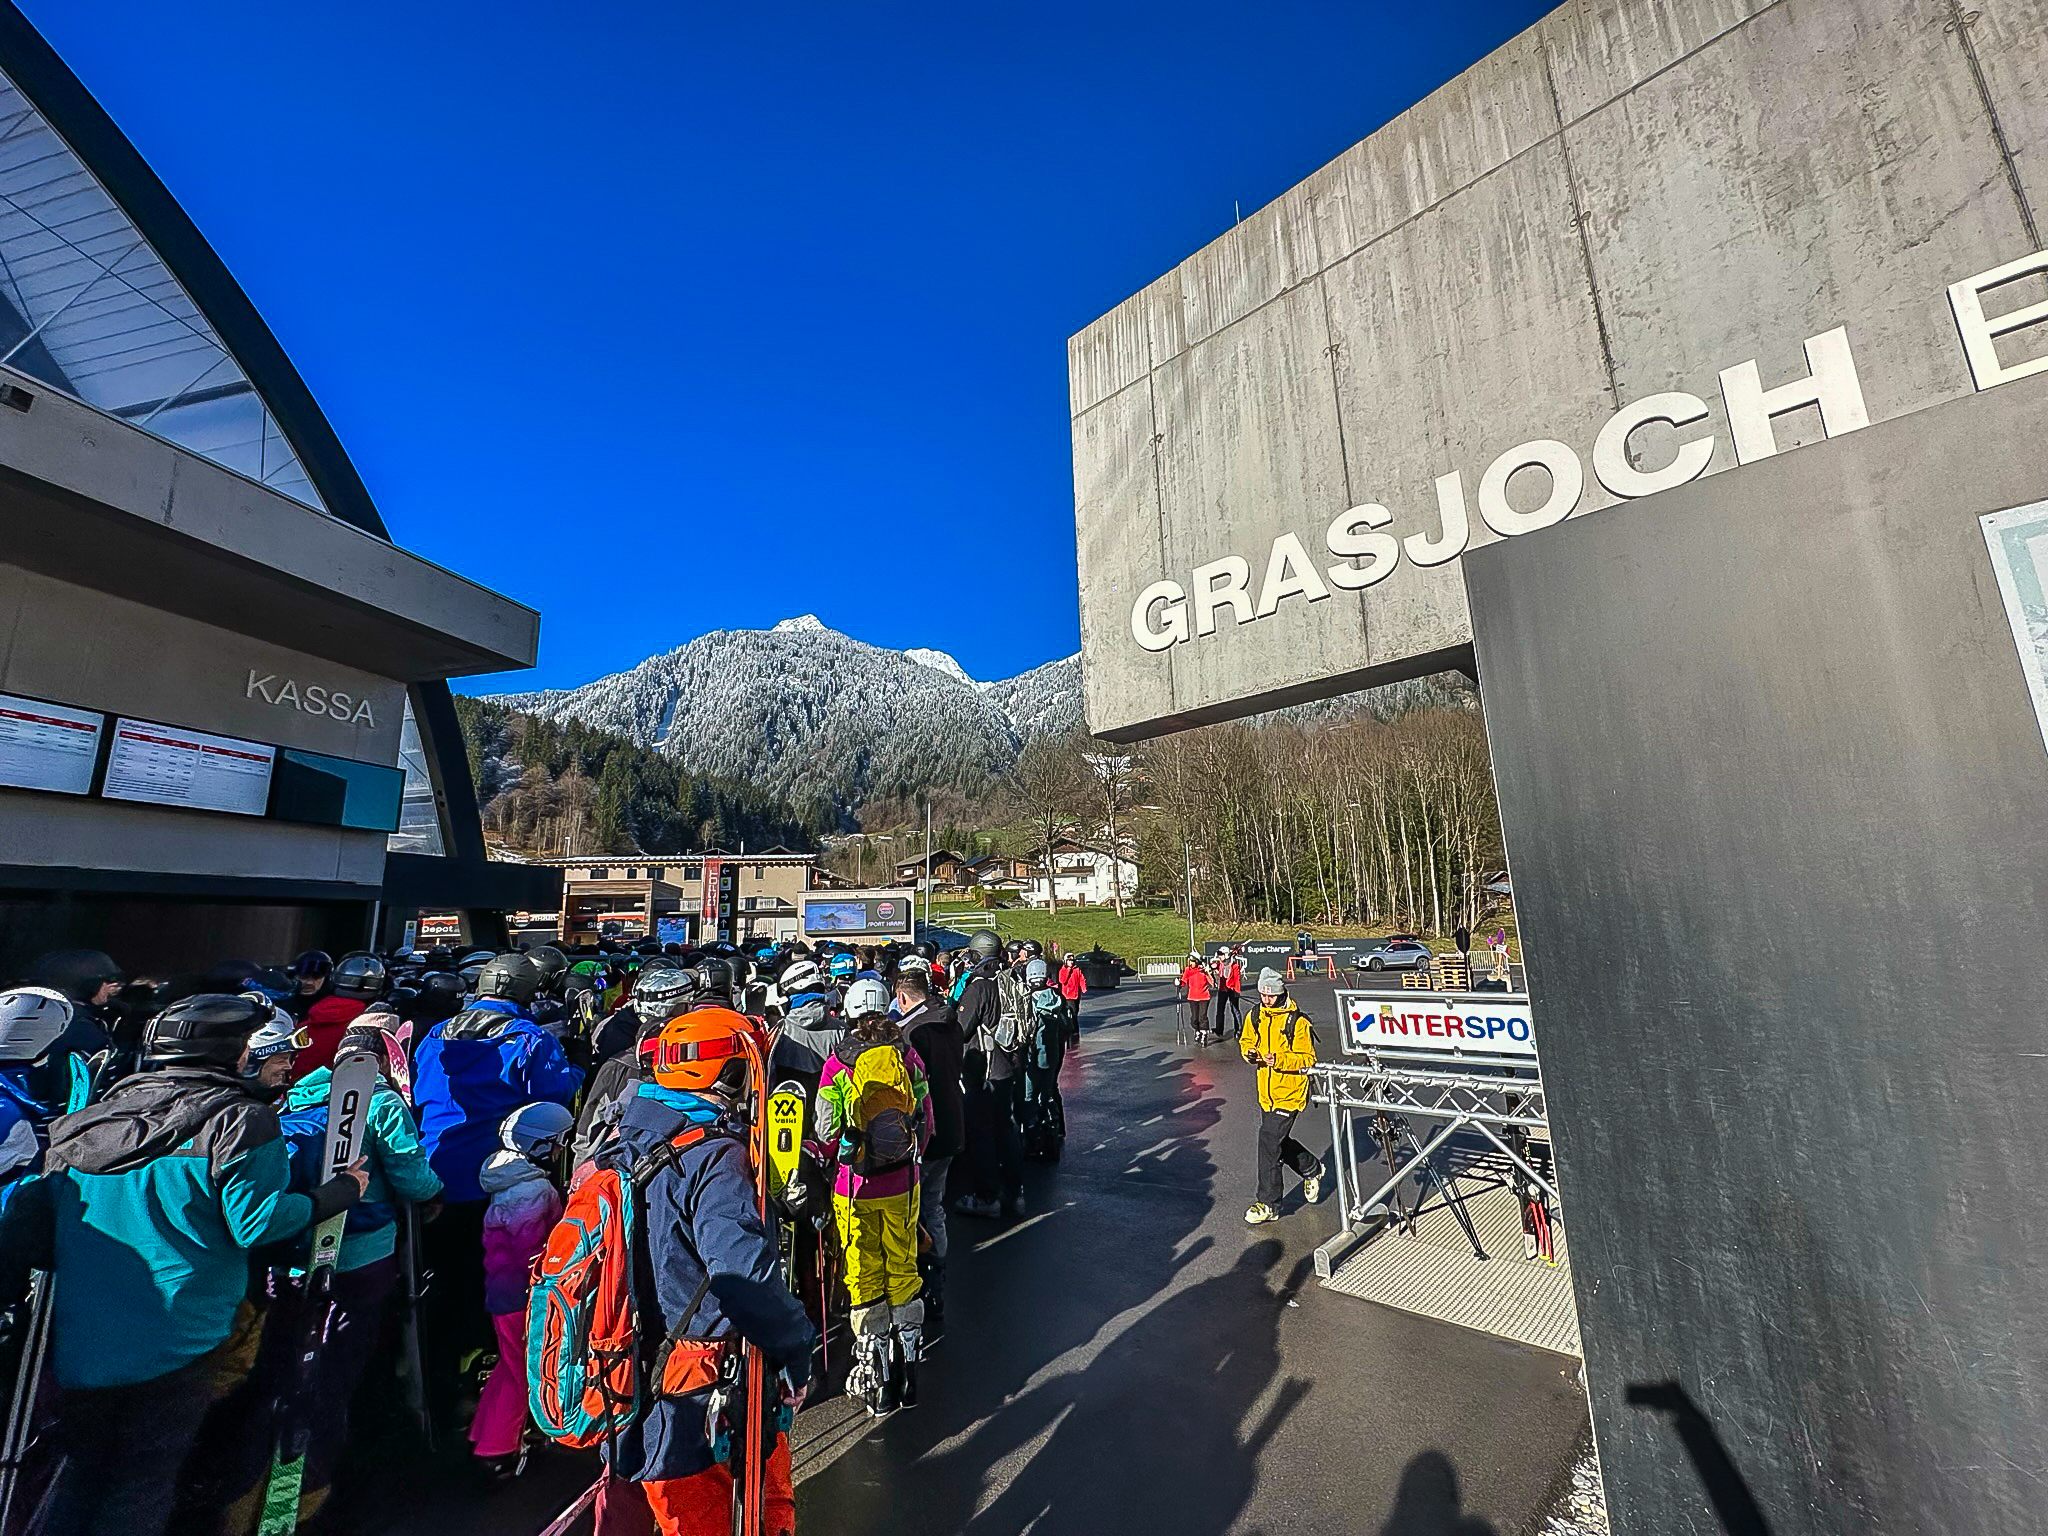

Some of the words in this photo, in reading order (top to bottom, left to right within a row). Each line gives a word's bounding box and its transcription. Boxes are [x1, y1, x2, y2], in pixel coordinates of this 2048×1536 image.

[1131, 325, 1870, 653] GRASJOCH
[246, 669, 375, 728] KASSA
[422, 925, 453, 934] Depot
[1247, 946, 1266, 954] Super
[1266, 946, 1292, 954] Charger
[255, 1045, 278, 1056] GIRO
